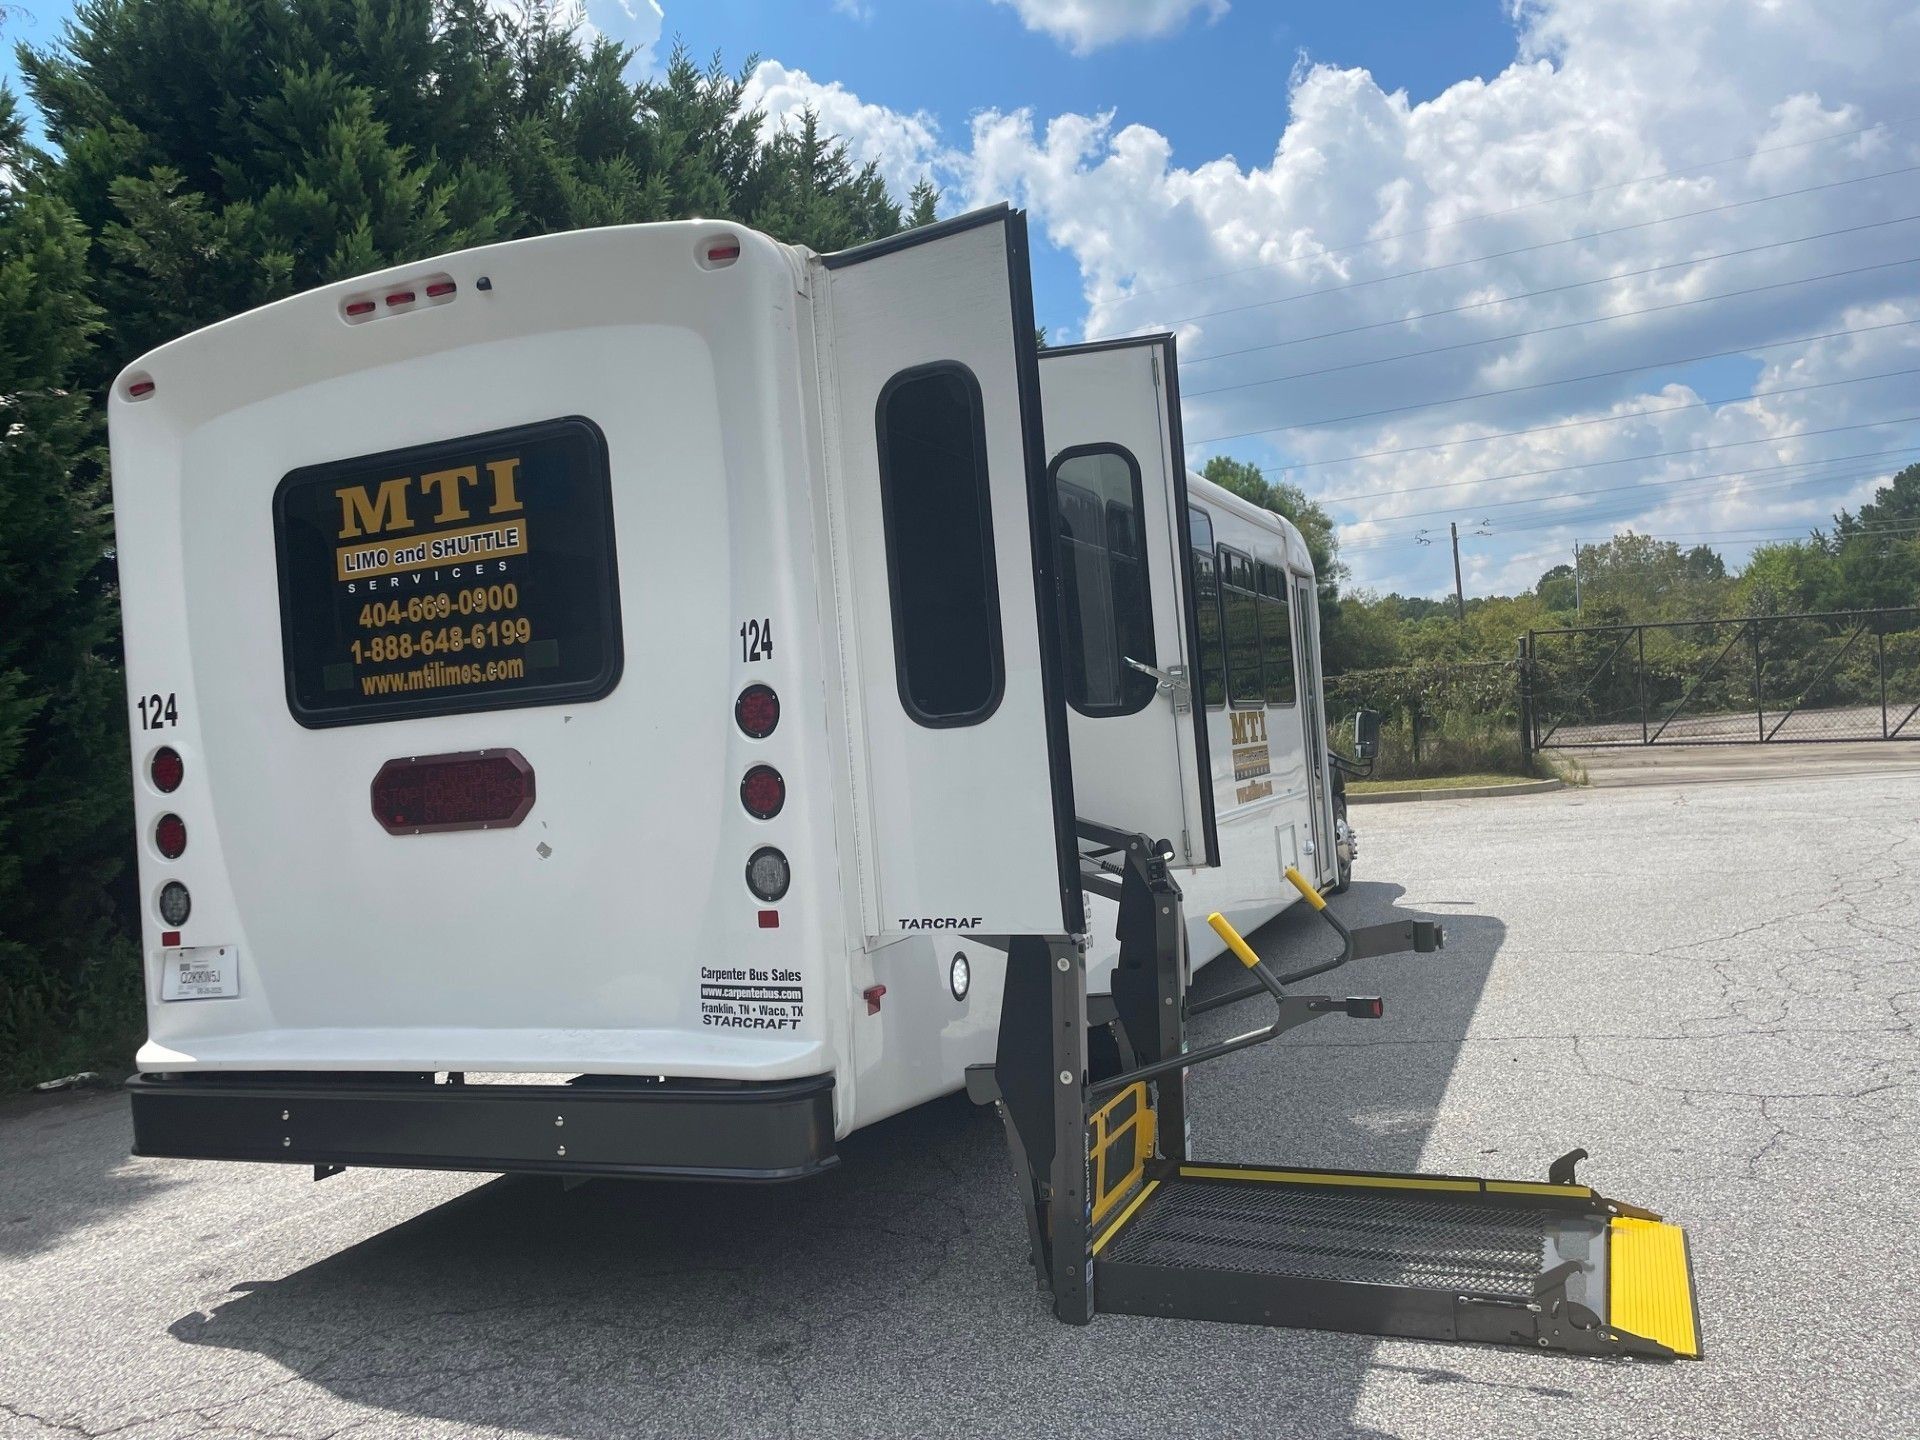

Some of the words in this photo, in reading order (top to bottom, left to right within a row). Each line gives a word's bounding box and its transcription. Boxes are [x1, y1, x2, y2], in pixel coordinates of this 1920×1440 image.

[335, 457, 524, 539] MTI
[344, 547, 389, 573] LIMO
[394, 541, 426, 565] and
[431, 527, 519, 559] SHUTTLE
[348, 560, 507, 594] SERVICES
[358, 583, 518, 629] 404-669-0900
[350, 617, 531, 665] 1-888-648-6199
[740, 618, 773, 663] 124
[361, 656, 525, 696] www.mtilimos.com
[137, 692, 178, 730] 124
[1229, 710, 1268, 746] MTI
[898, 917, 983, 930] TARCRAF
[701, 966, 747, 982] Carpenter
[749, 968, 769, 981] Bus
[771, 968, 802, 982] Sales
[701, 1002, 737, 1015] Franklin,
[738, 1004, 750, 1015] TN
[758, 1004, 789, 1018] Waco,
[790, 1005, 804, 1017] TX
[702, 987, 802, 1000] www.carpenterbus.com
[702, 1014, 801, 1030] STARCRAFT
